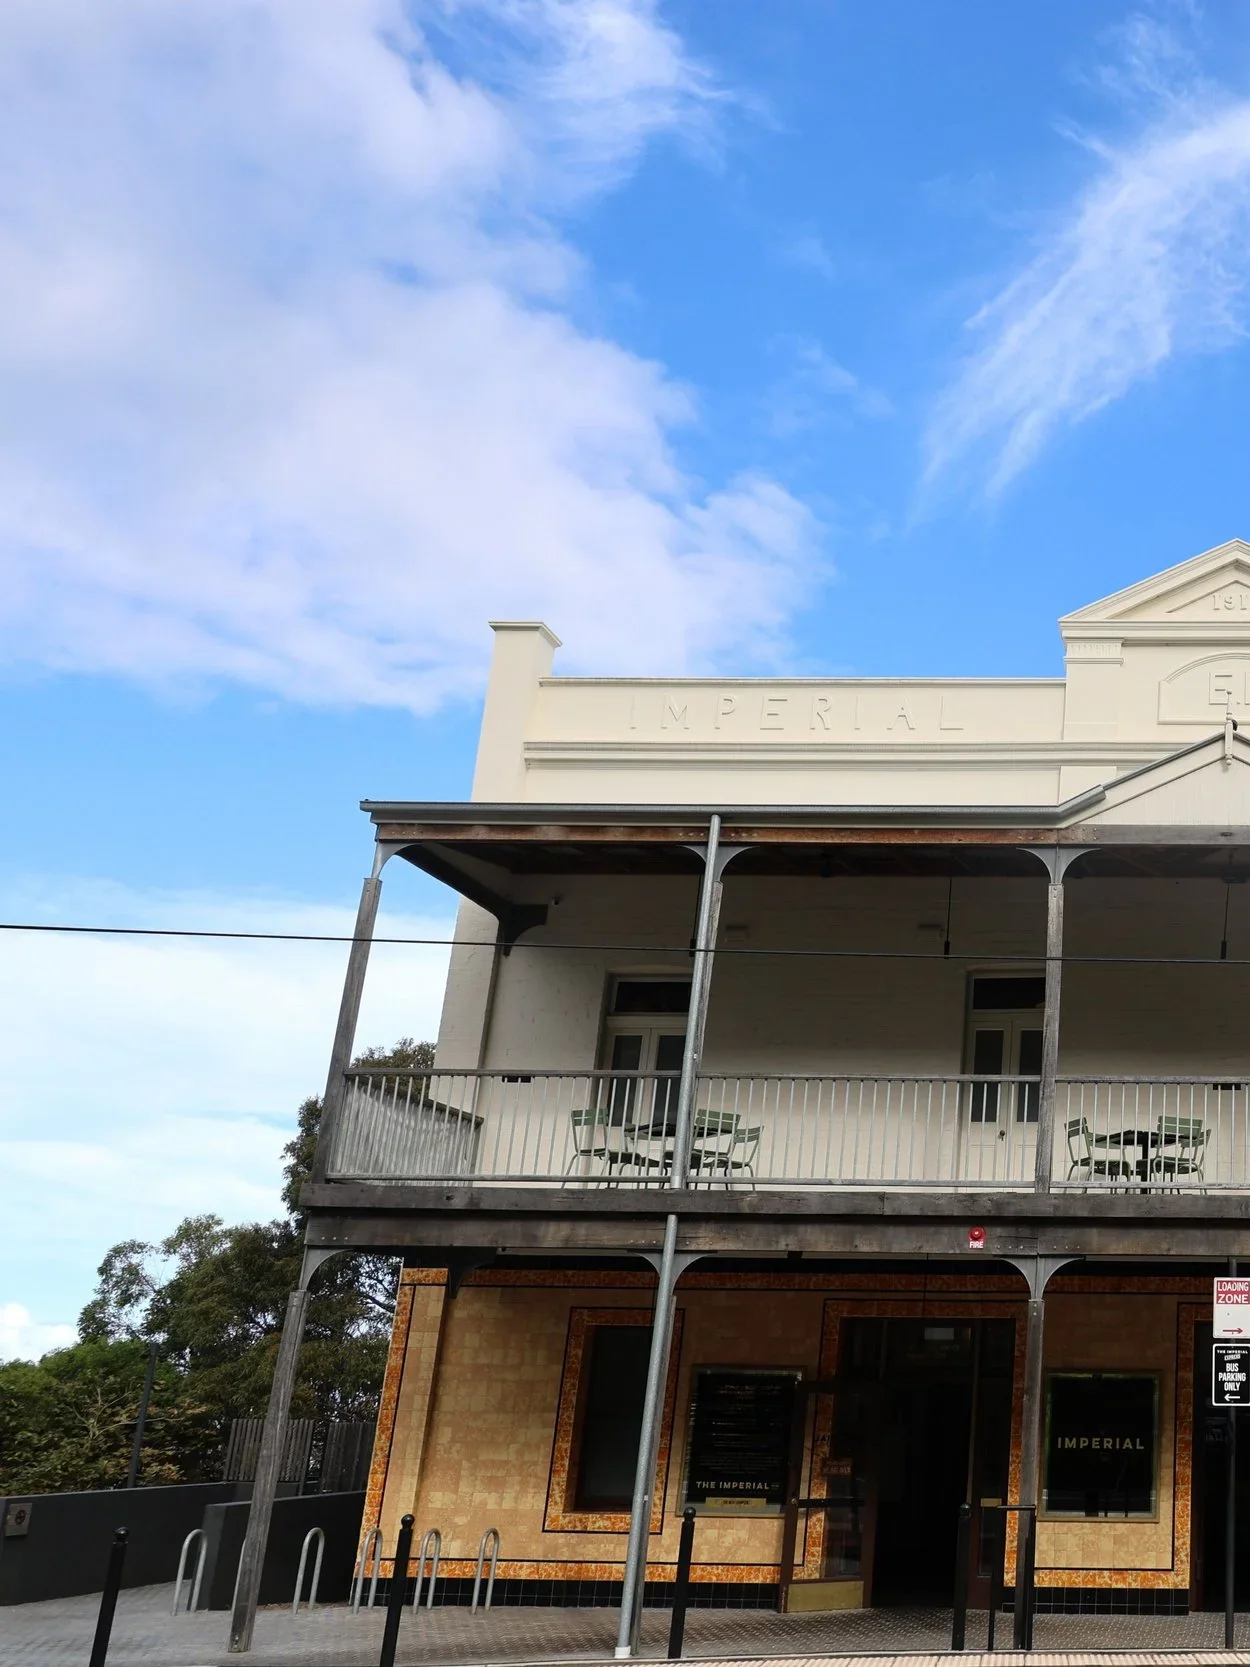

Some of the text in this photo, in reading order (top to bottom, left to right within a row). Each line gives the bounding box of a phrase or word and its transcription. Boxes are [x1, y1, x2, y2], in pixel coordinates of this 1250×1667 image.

[629, 694, 965, 731] IMPERIAL
[969, 1241, 984, 1249] FIRE
[1217, 1282, 1249, 1292] LOADING
[1218, 1294, 1249, 1304] ZONE
[1226, 1363, 1239, 1372] BUS
[1218, 1372, 1246, 1382] PARKING
[1224, 1382, 1240, 1391] ONLY
[1057, 1437, 1145, 1449] IMPERIAL
[696, 1481, 716, 1489] THE
[719, 1481, 770, 1490] IMPERIAL
